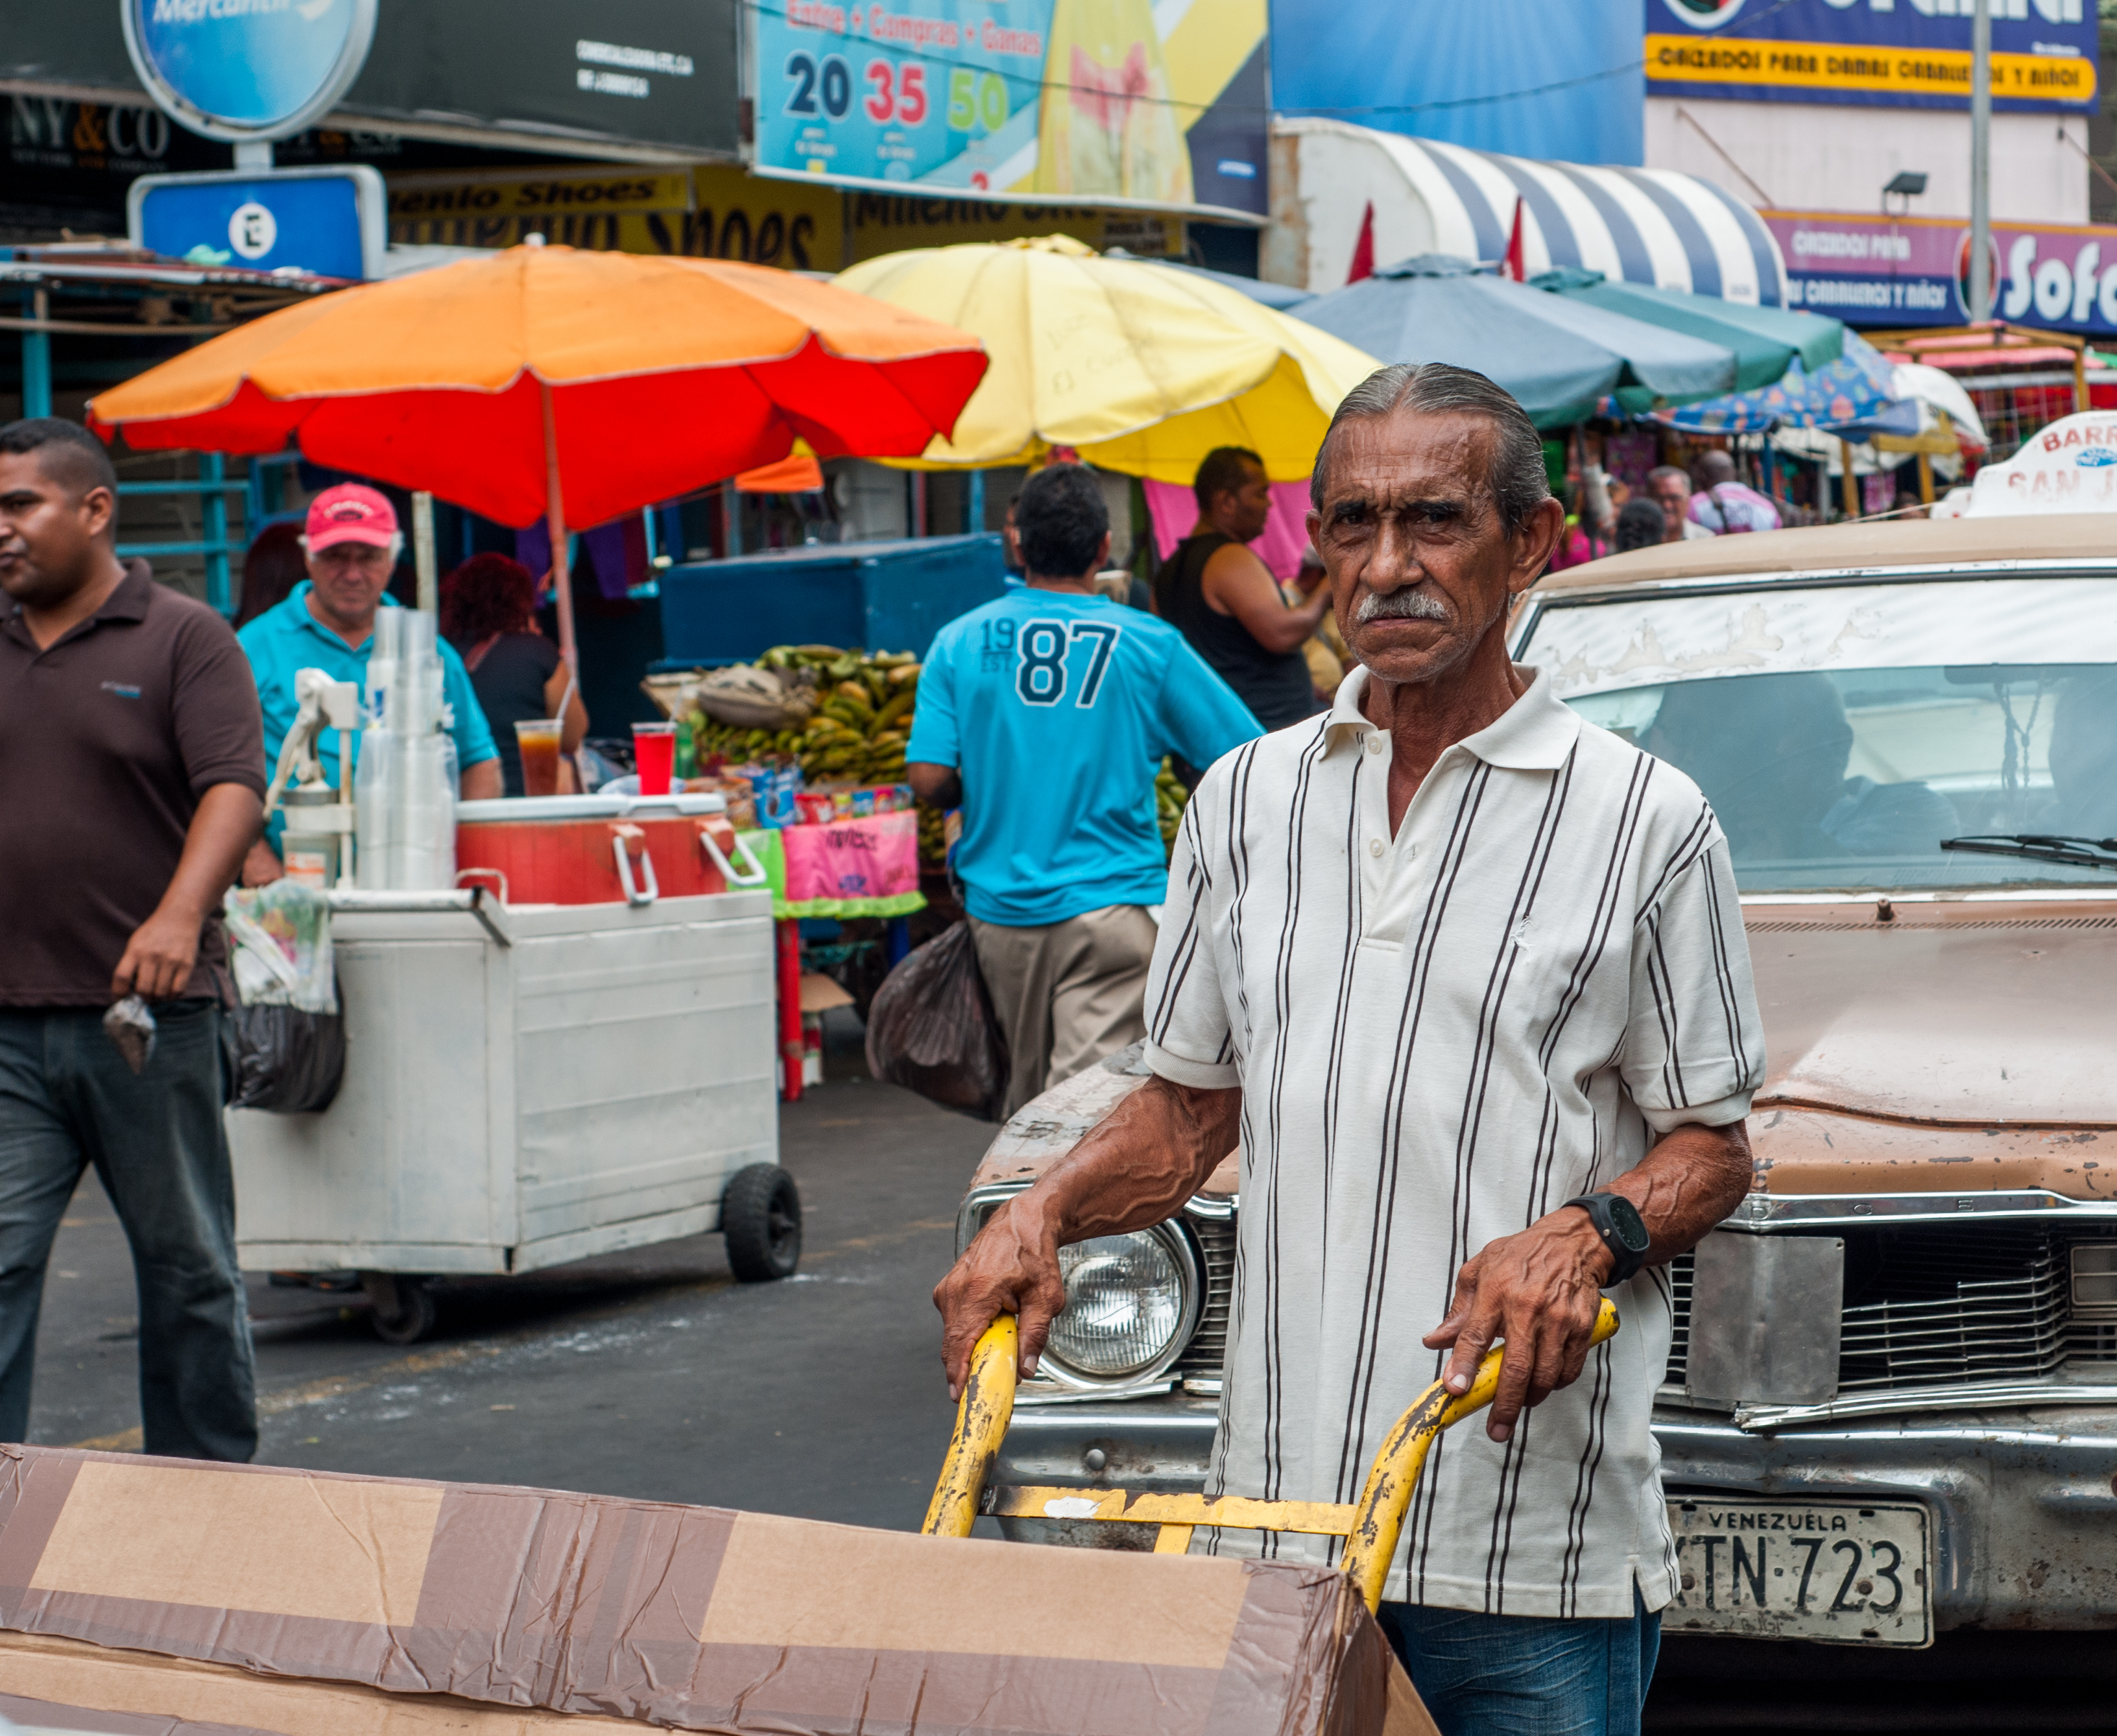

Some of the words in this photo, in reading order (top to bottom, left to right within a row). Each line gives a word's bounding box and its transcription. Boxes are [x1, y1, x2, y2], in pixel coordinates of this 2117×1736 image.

[869, 5, 958, 51] Compras
[982, 18, 1042, 56] Ganas
[1659, 47, 1760, 69] CALZADOS
[1771, 53, 1818, 73] PARA
[1827, 56, 1889, 77] DAMAS
[1898, 60, 2003, 84] CABALLEOS
[783, 52, 853, 120] 20
[864, 60, 929, 125] 35
[948, 67, 1008, 131] 50
[515, 180, 656, 208] Shoes
[2008, 470, 2081, 502] SAN
[2095, 468, 2117, 501] J
[980, 654, 1011, 673] EST
[981, 617, 1014, 650] 19
[1016, 619, 1121, 709] 87
[1708, 1512, 1847, 1532] VENEZUELA
